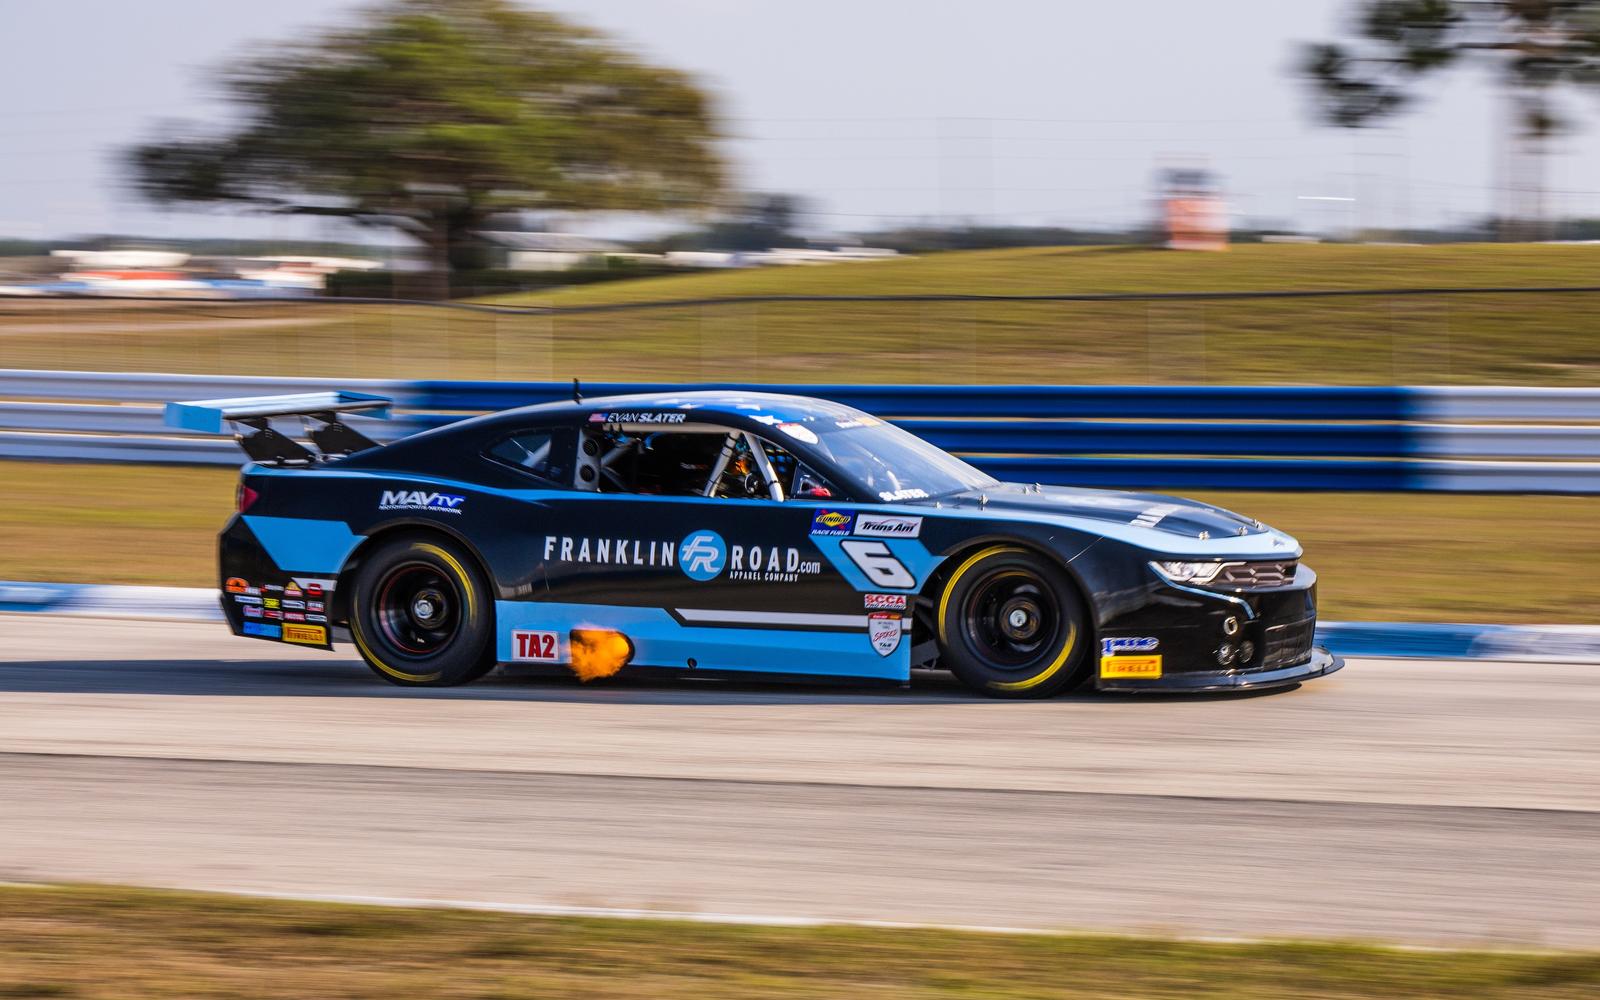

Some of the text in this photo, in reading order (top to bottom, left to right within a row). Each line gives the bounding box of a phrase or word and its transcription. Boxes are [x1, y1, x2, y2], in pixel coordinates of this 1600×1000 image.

[607, 412, 687, 423] EVAN SLATER
[816, 515, 851, 524] SUNOCO
[862, 521, 916, 533] Trans Am
[543, 536, 675, 567] FRANKLIN
[840, 539, 917, 589] 6
[729, 571, 799, 582] APPAREL COMPANY
[866, 594, 905, 604] SCCA
[516, 634, 555, 658] TA2
[1105, 659, 1158, 673] PIRELLI
